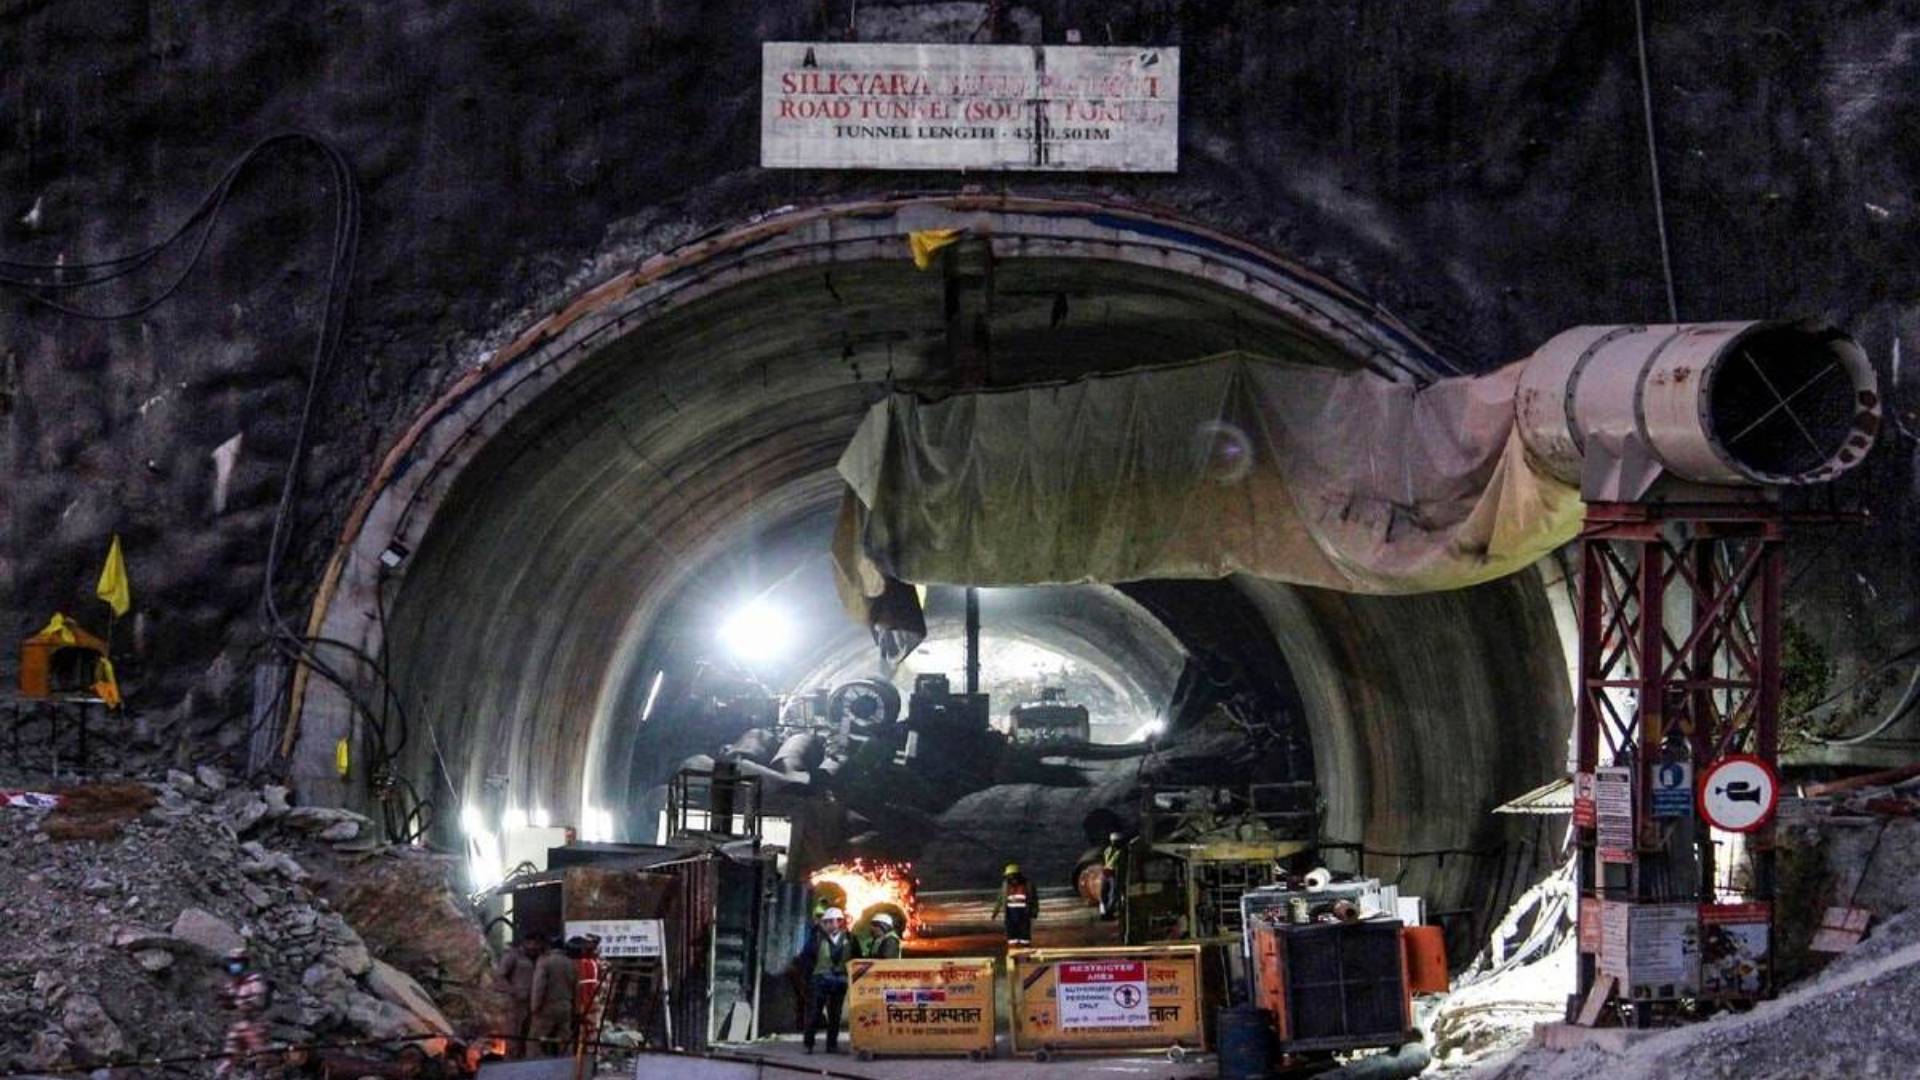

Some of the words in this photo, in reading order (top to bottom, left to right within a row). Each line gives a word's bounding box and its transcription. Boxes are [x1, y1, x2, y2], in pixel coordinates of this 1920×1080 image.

[781, 73, 931, 95] SILKYARA
[780, 99, 851, 119] ROAD
[833, 125, 912, 138] TUNNEL
[917, 126, 995, 139] LENGTH
[1069, 963, 1135, 972] RESTRICTED
